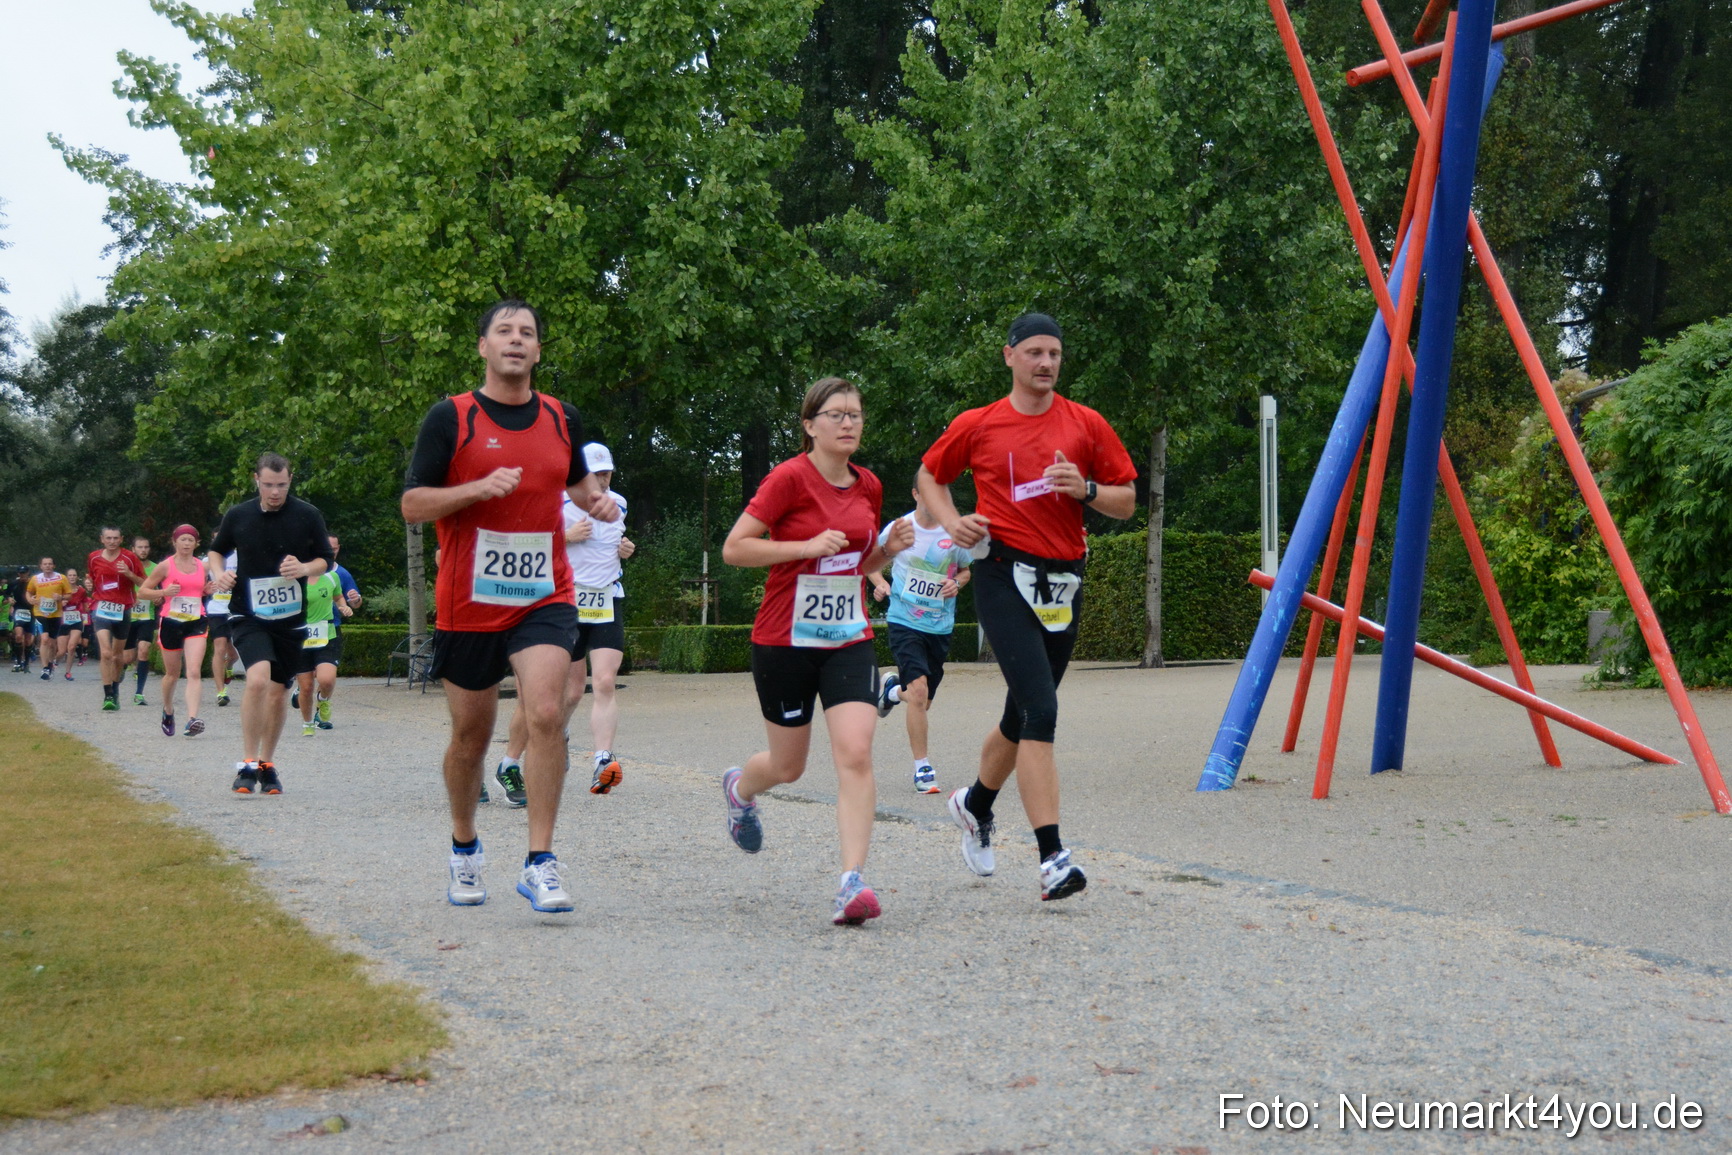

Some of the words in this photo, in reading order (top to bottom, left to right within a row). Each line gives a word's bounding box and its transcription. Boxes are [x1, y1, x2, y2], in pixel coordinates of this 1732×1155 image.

[484, 550, 547, 578] 2882
[494, 583, 536, 597] Thomas
[909, 578, 943, 597] 2067
[257, 585, 296, 605] 2851
[578, 592, 605, 607] 275
[100, 600, 122, 612] 2413
[181, 603, 193, 614] 51
[803, 594, 855, 621] 2581
[578, 610, 603, 618] Christian
[816, 628, 848, 639] Carina
